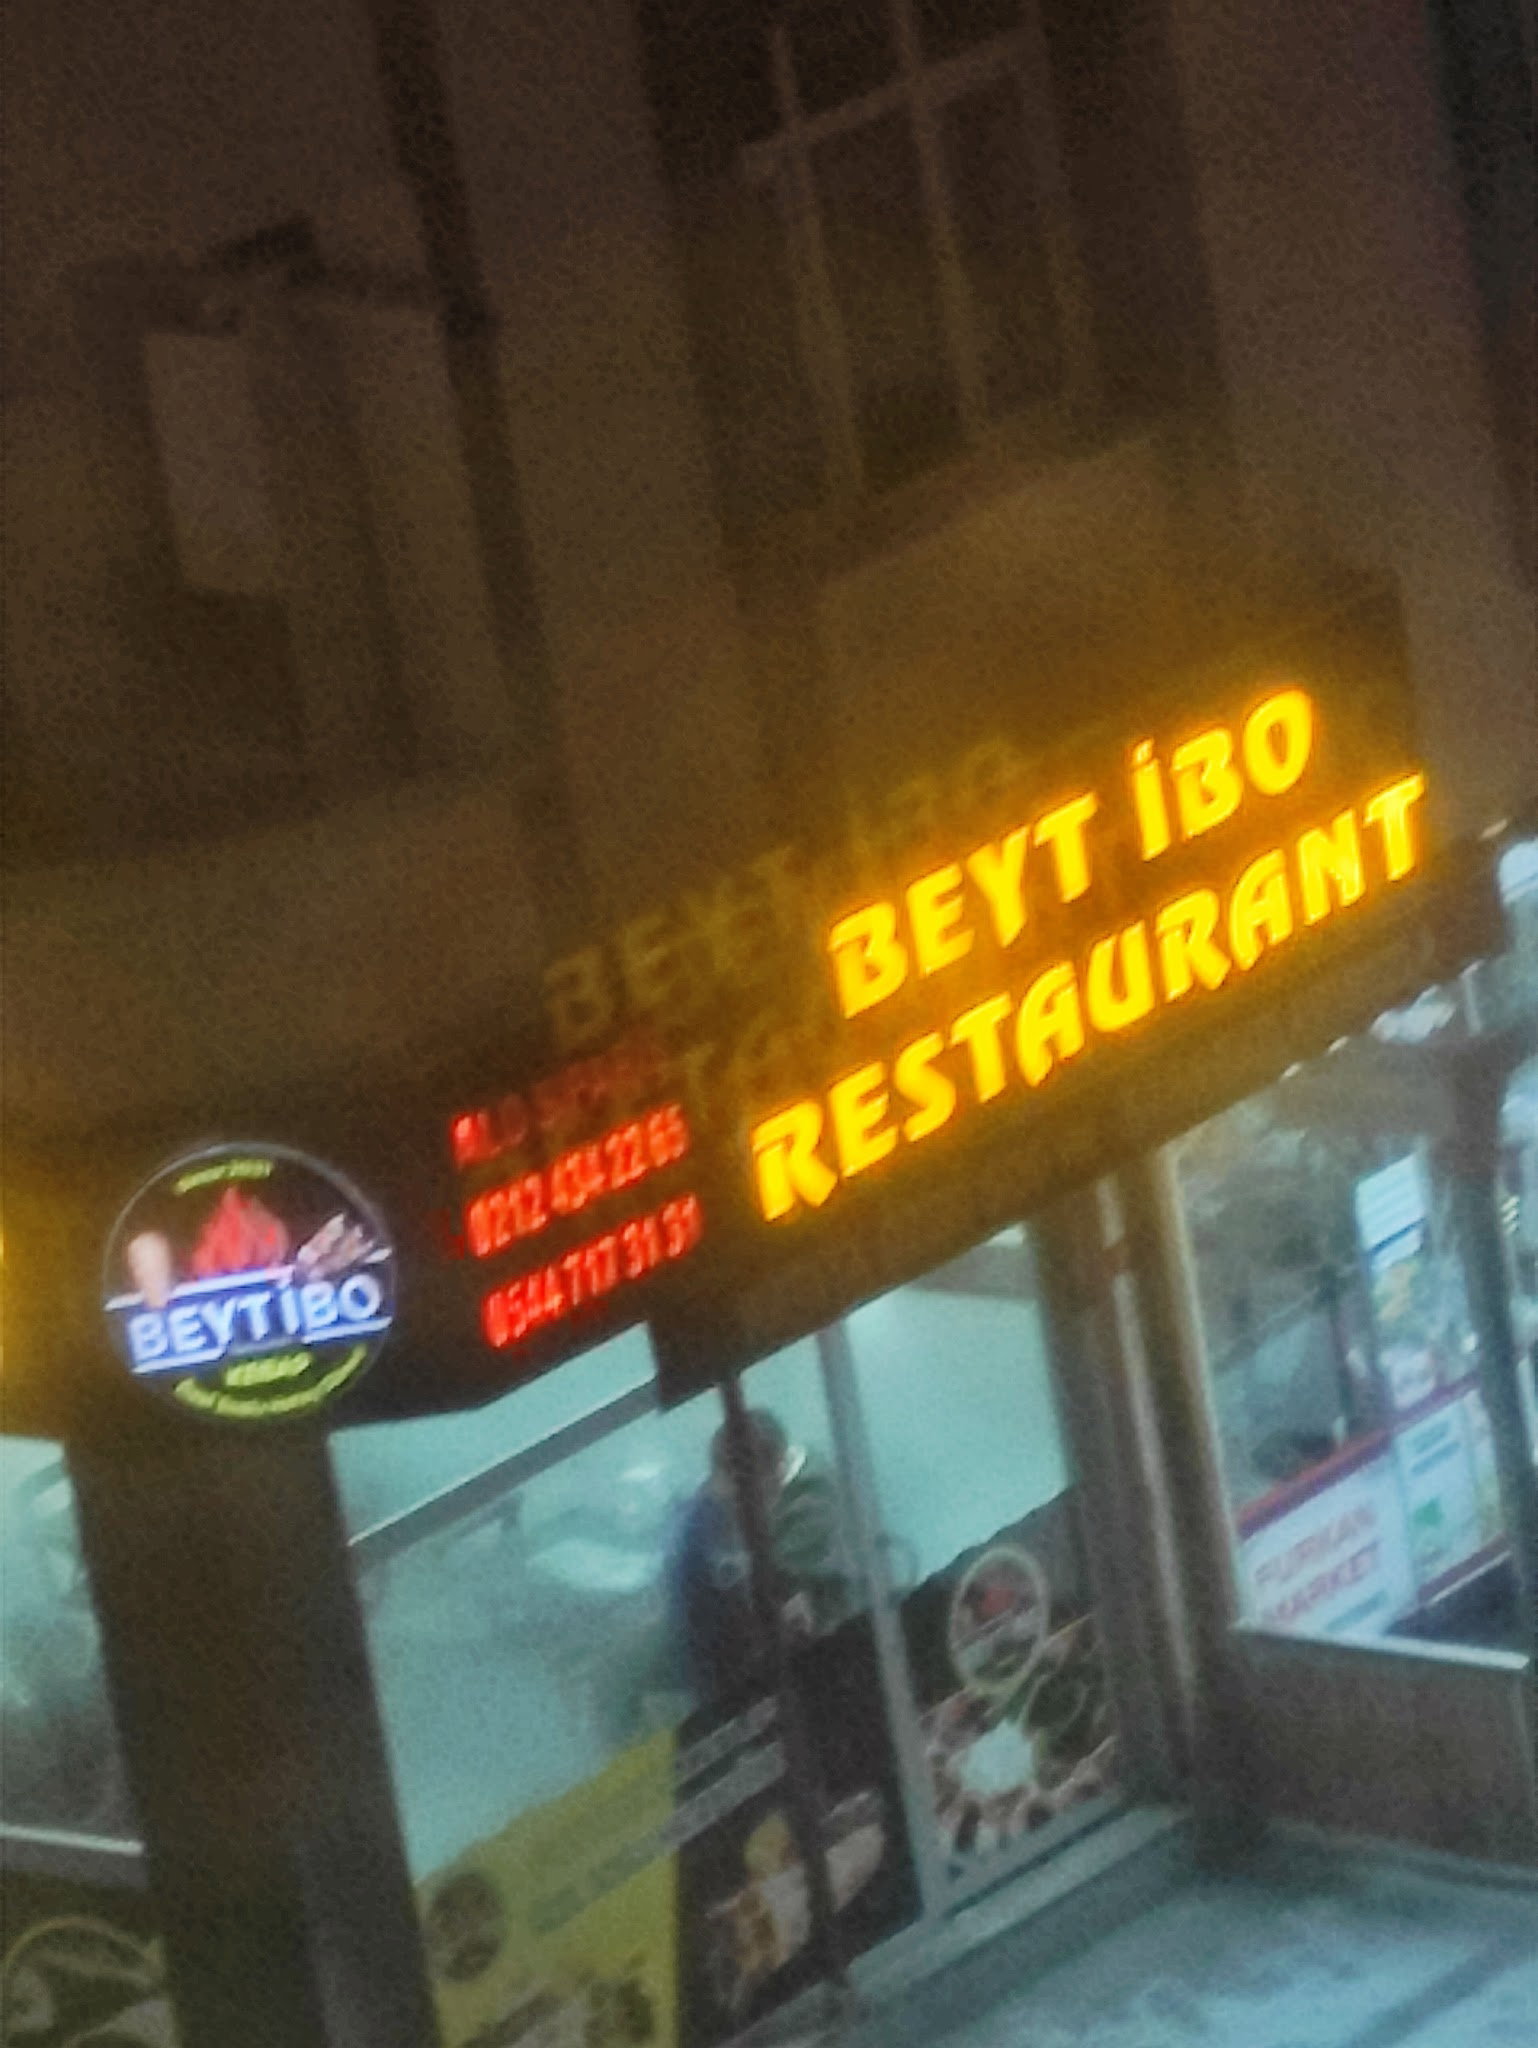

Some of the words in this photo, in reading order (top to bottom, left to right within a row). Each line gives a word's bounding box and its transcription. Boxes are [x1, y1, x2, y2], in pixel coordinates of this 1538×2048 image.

[750, 770, 1426, 1222] RESTAURANT
[828, 791, 1099, 1019] BEYT
[1130, 687, 1315, 861] İBO
